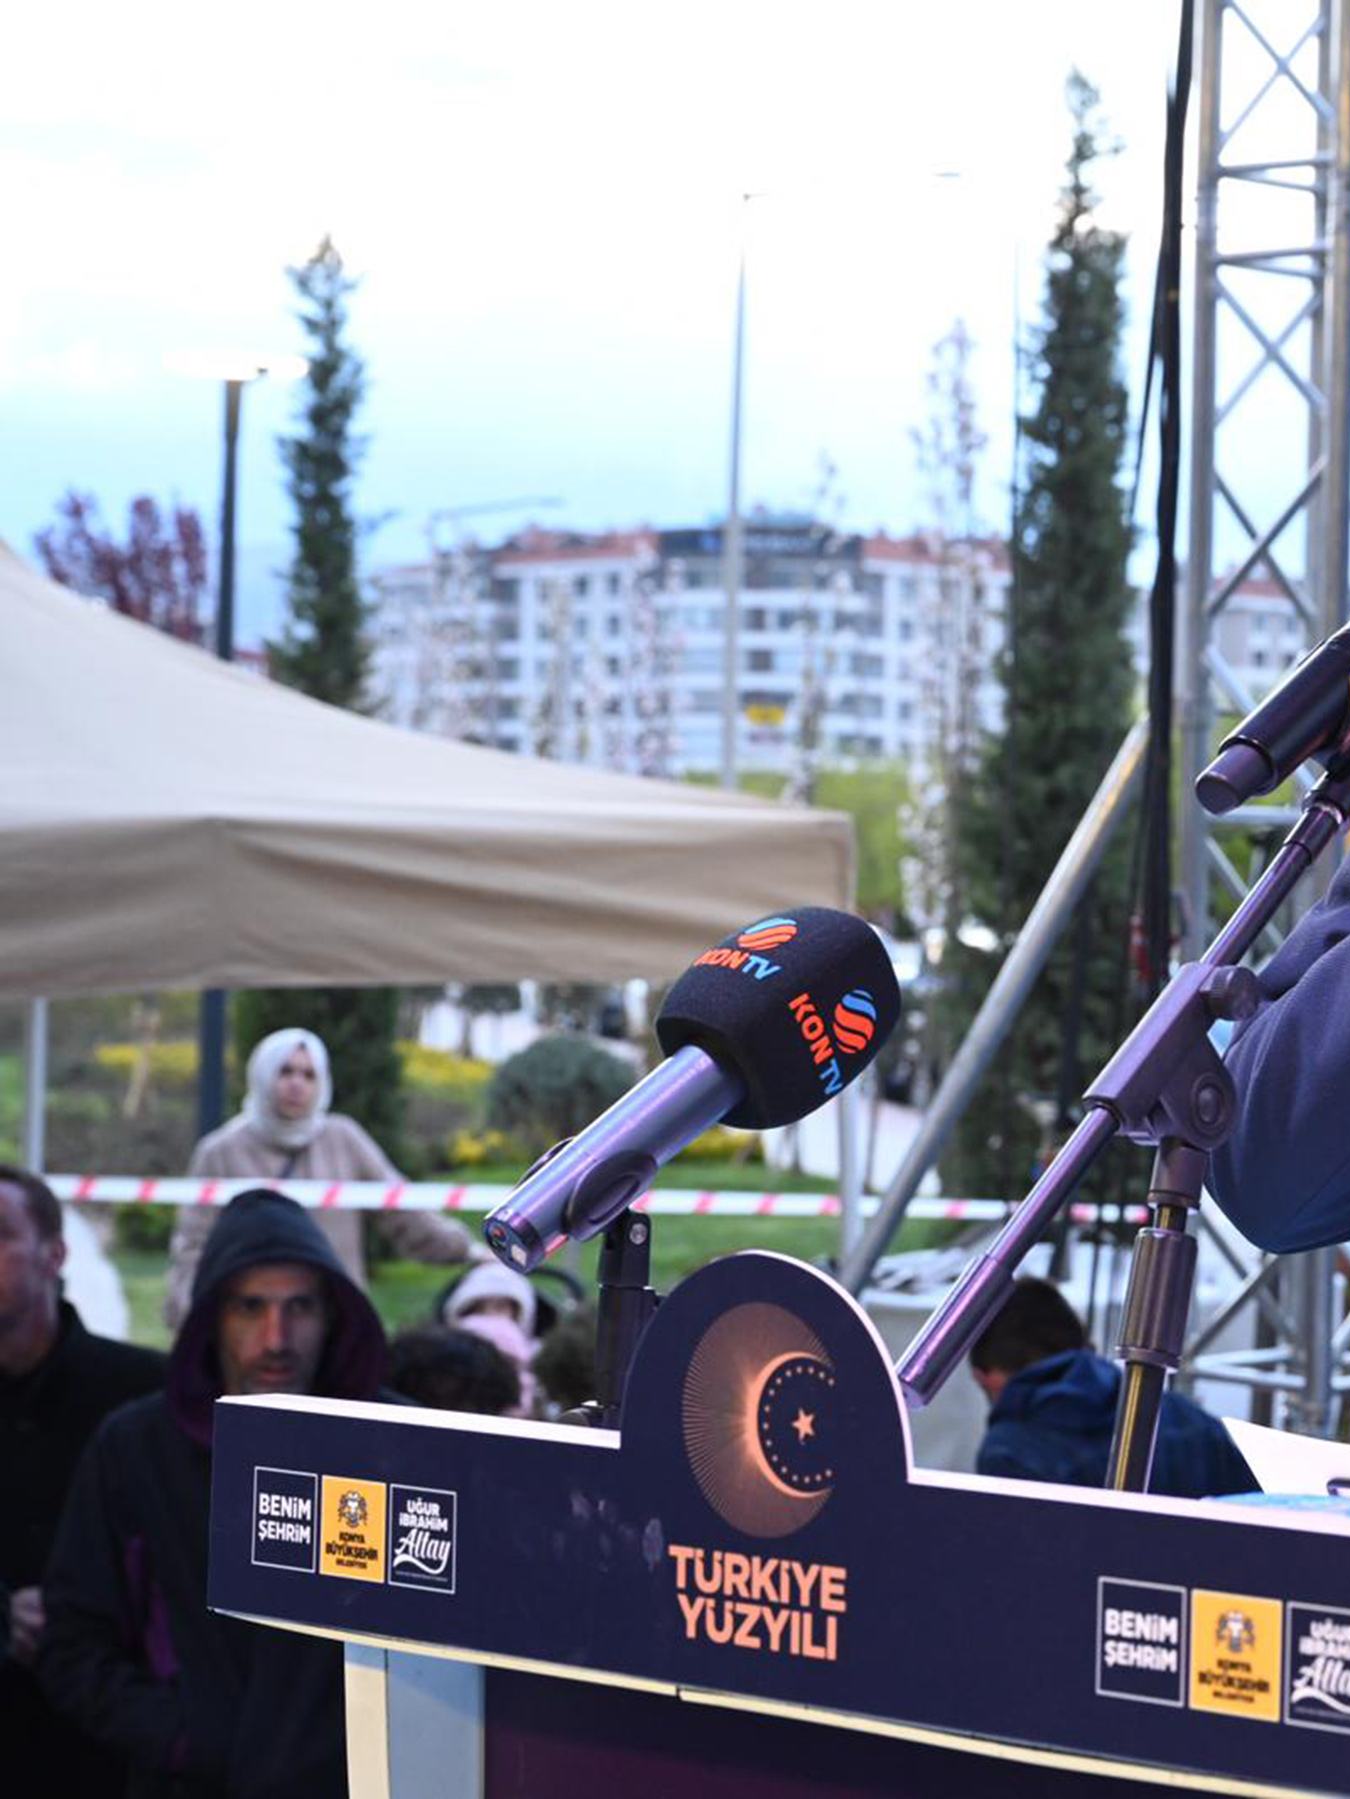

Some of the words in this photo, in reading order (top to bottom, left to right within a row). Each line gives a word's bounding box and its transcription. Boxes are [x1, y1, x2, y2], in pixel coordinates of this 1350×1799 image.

[258, 1520, 311, 1544] ŞEHRİM
[677, 1593, 838, 1661] YÜZYILI
[1104, 1640, 1177, 1673] ŞEHRİM
